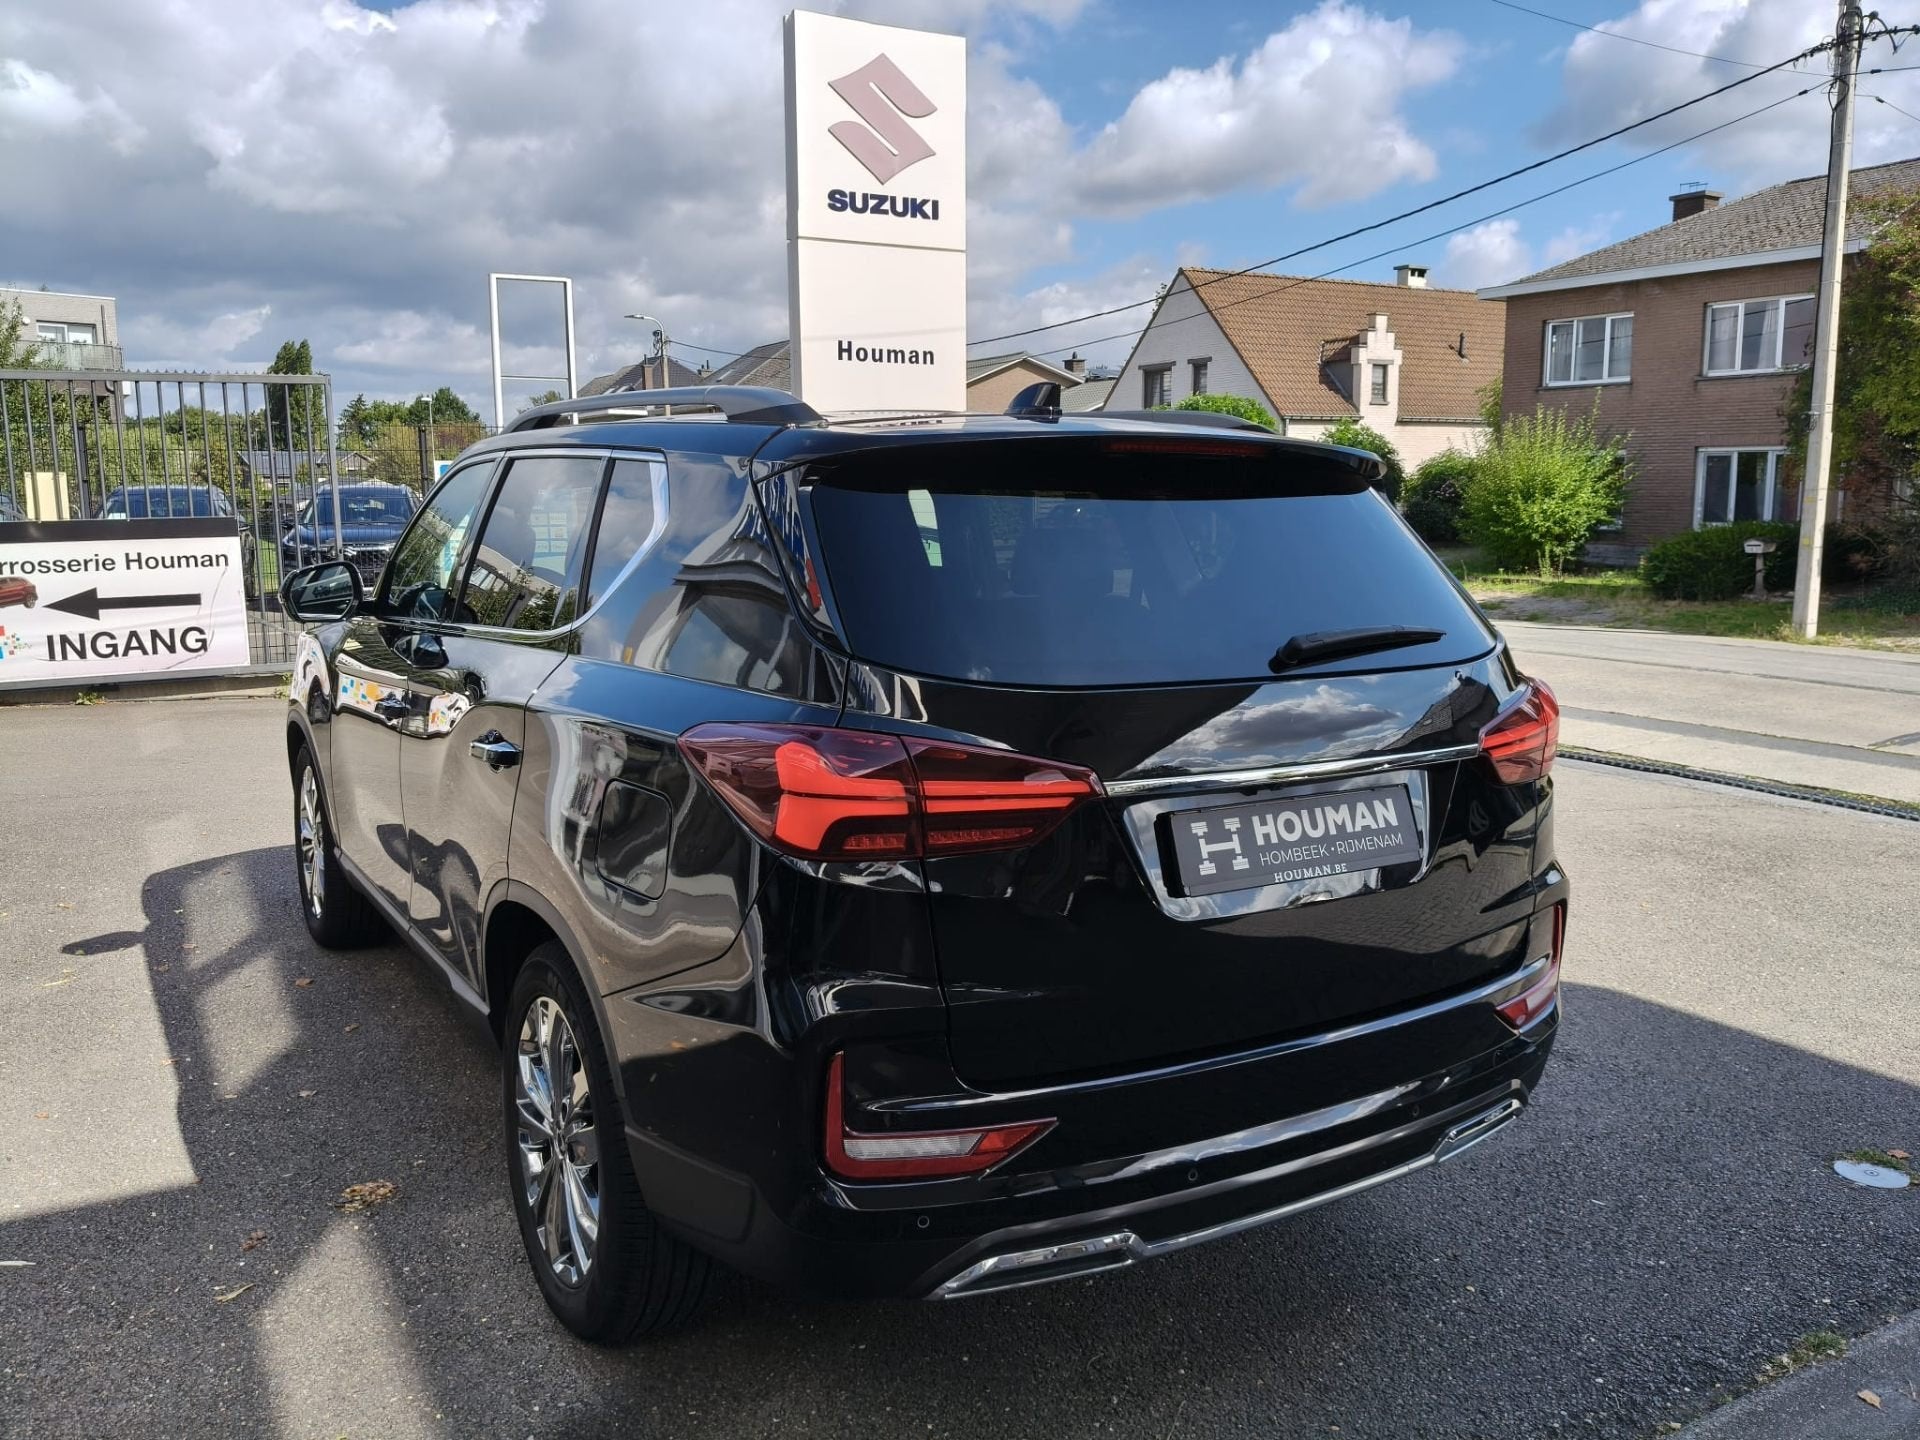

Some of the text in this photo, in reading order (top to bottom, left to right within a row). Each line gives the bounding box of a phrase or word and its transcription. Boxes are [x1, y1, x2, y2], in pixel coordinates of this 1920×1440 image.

[827, 189, 939, 220] SUZUKI
[837, 340, 935, 365] Houman
[125, 552, 229, 571] Houman
[46, 626, 208, 662] INGANG
[1252, 798, 1399, 844] HOUMAN
[1260, 833, 1404, 865] HOMBEEK RIJMENAM
[1273, 863, 1348, 883] HOUMAN.BE
